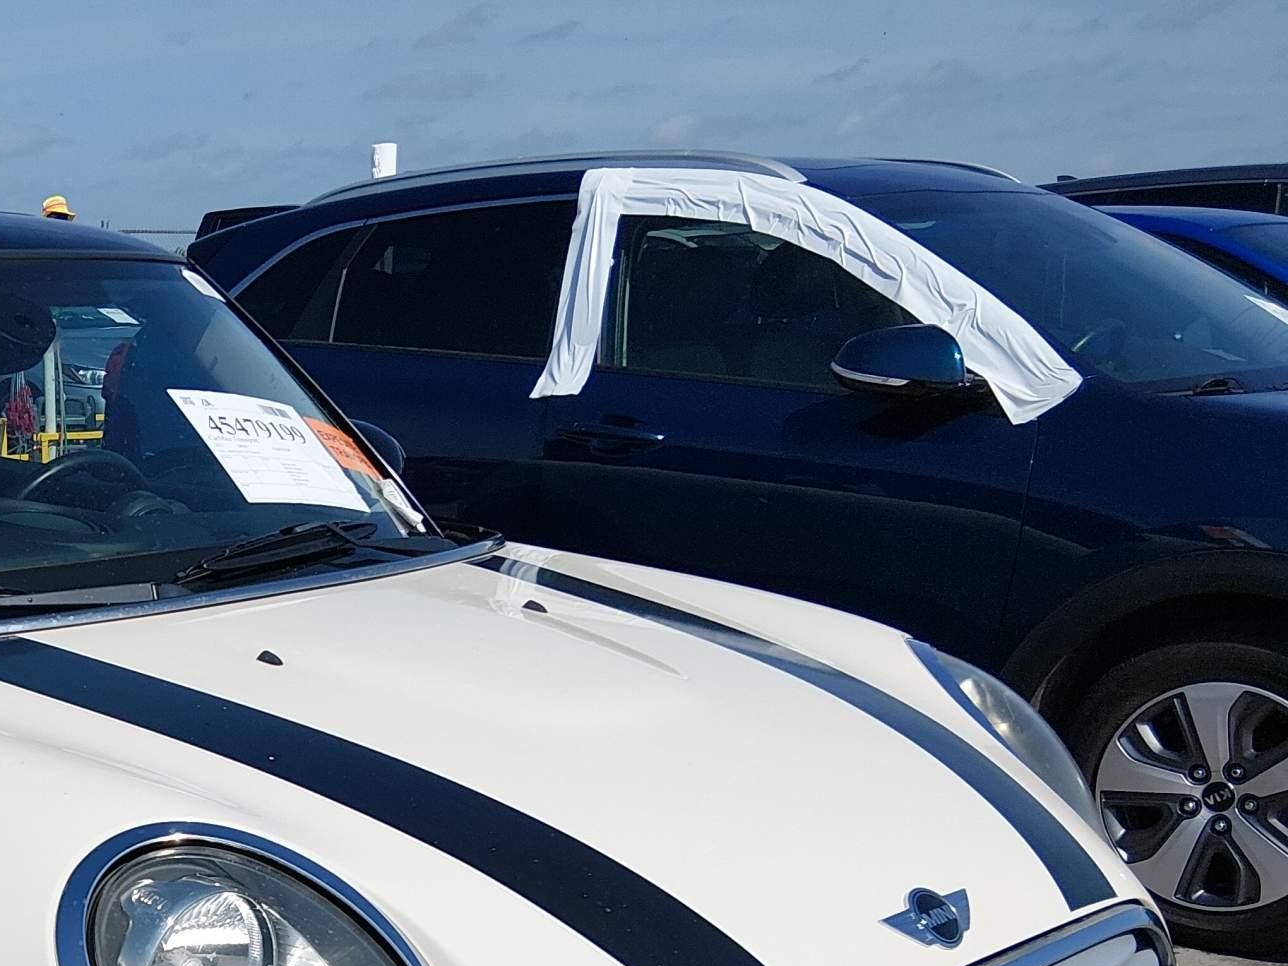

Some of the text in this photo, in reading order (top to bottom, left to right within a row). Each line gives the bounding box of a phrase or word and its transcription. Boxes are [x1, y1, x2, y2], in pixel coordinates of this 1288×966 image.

[207, 414, 307, 444] 45479199
[1204, 787, 1232, 806] KIA
[920, 904, 956, 928] MINI
